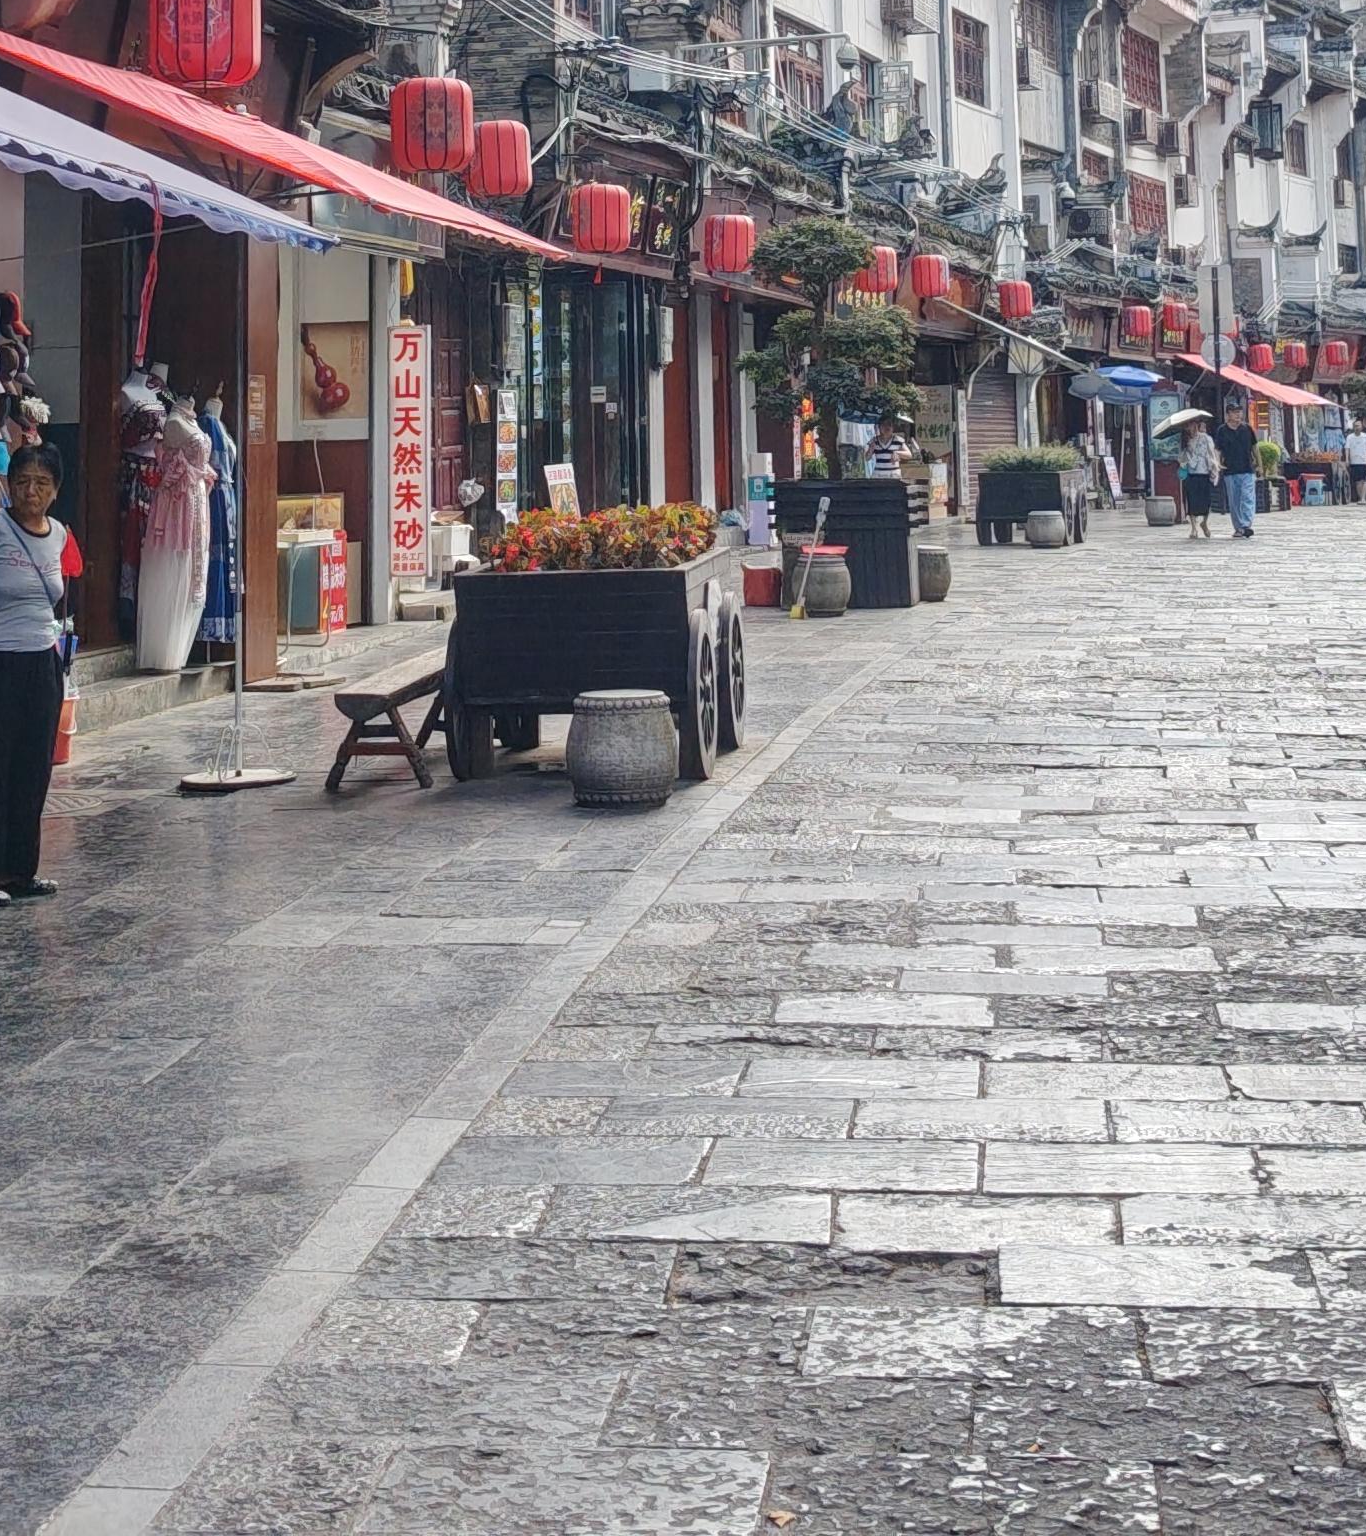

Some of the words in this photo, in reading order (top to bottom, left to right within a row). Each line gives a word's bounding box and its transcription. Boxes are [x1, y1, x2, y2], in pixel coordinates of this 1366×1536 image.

[393, 333, 424, 550] 万山天然朱砂
